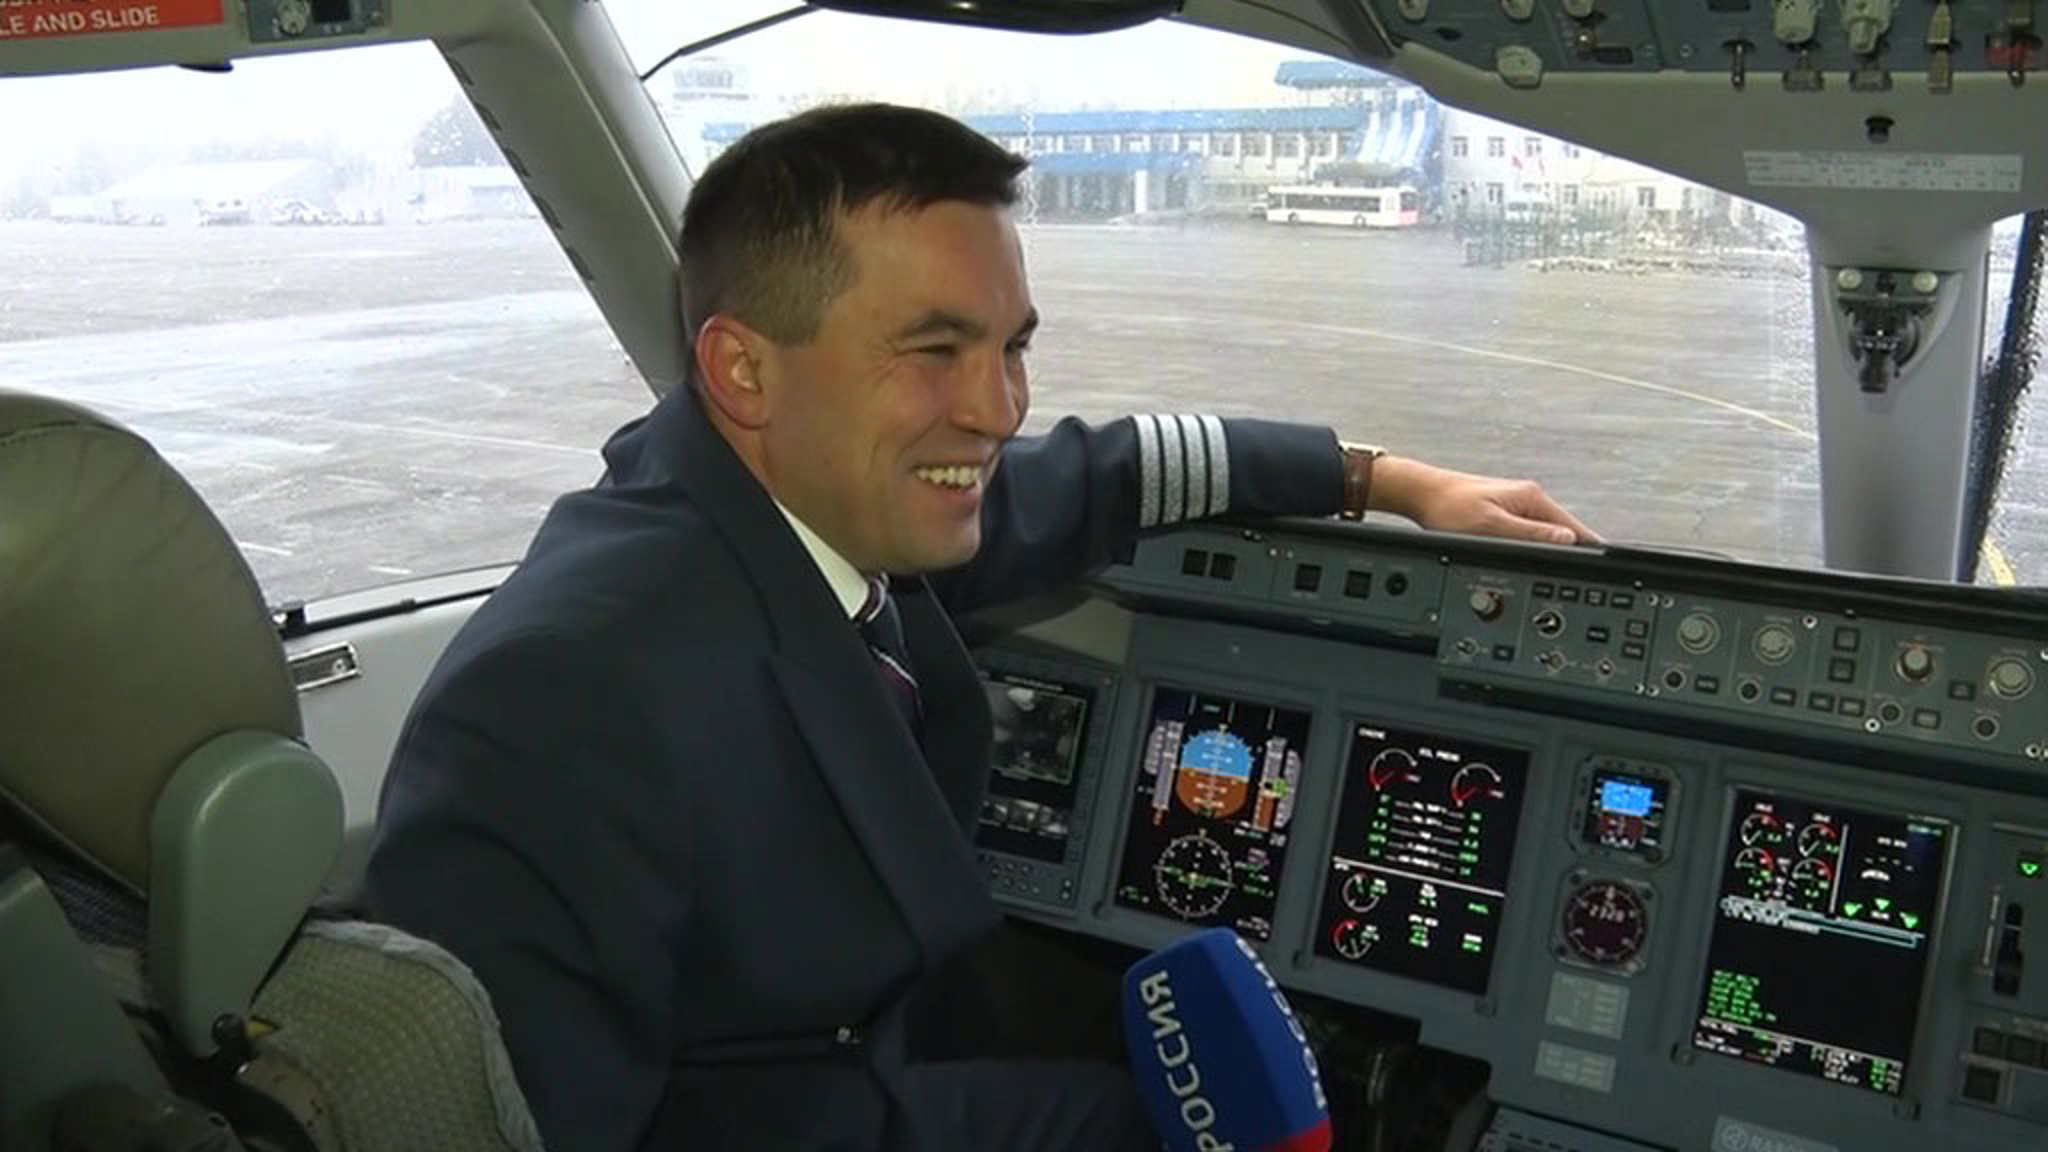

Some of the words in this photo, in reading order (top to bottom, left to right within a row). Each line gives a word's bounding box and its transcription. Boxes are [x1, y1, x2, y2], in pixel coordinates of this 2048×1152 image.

[34, 11, 86, 33] AND
[90, 6, 158, 29] SLIDE
[1139, 969, 1235, 1152] РОССИЯ
